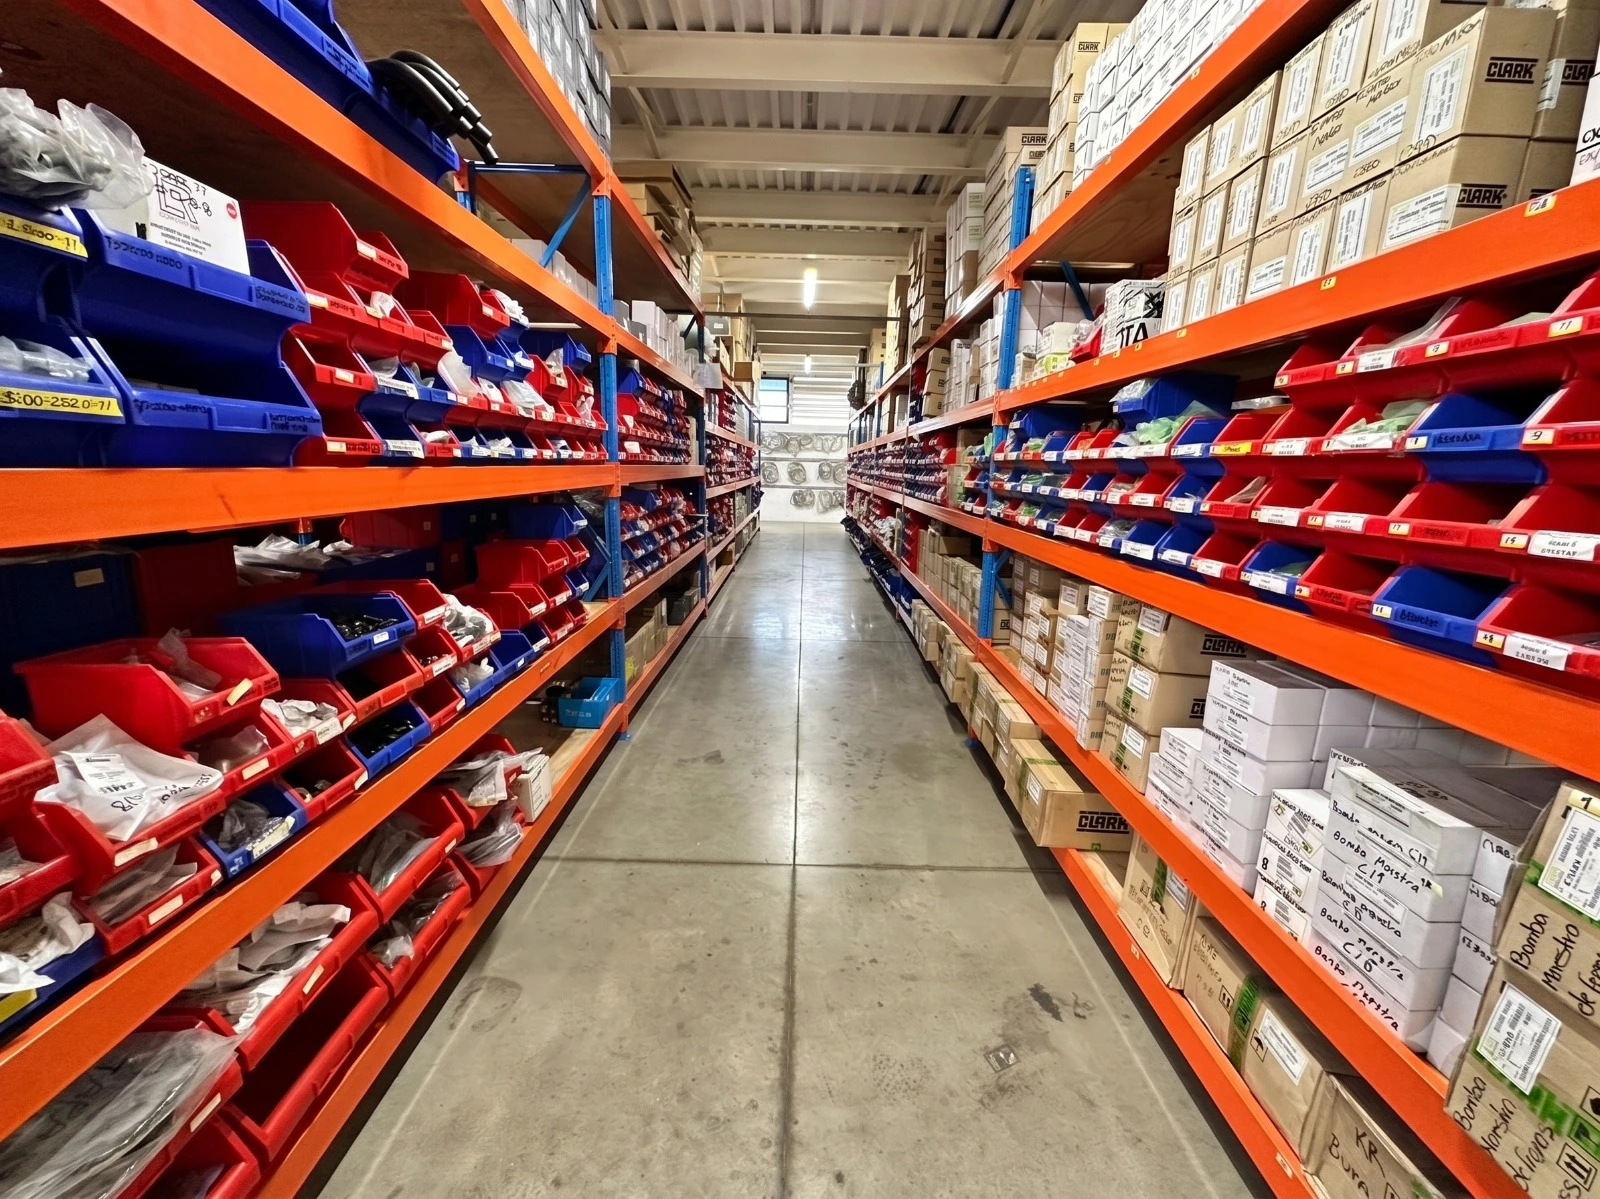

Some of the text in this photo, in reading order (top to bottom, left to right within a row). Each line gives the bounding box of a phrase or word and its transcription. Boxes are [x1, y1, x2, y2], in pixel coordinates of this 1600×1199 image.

[1486, 62, 1537, 80] CLARK
[1457, 188, 1504, 205] CLARK
[1202, 637, 1247, 654] CLARK
[1077, 815, 1130, 831] CLARK
[1510, 913, 1550, 970] Bomba
[1453, 1076, 1487, 1132] Bomba
[1355, 1127, 1386, 1179] KR
